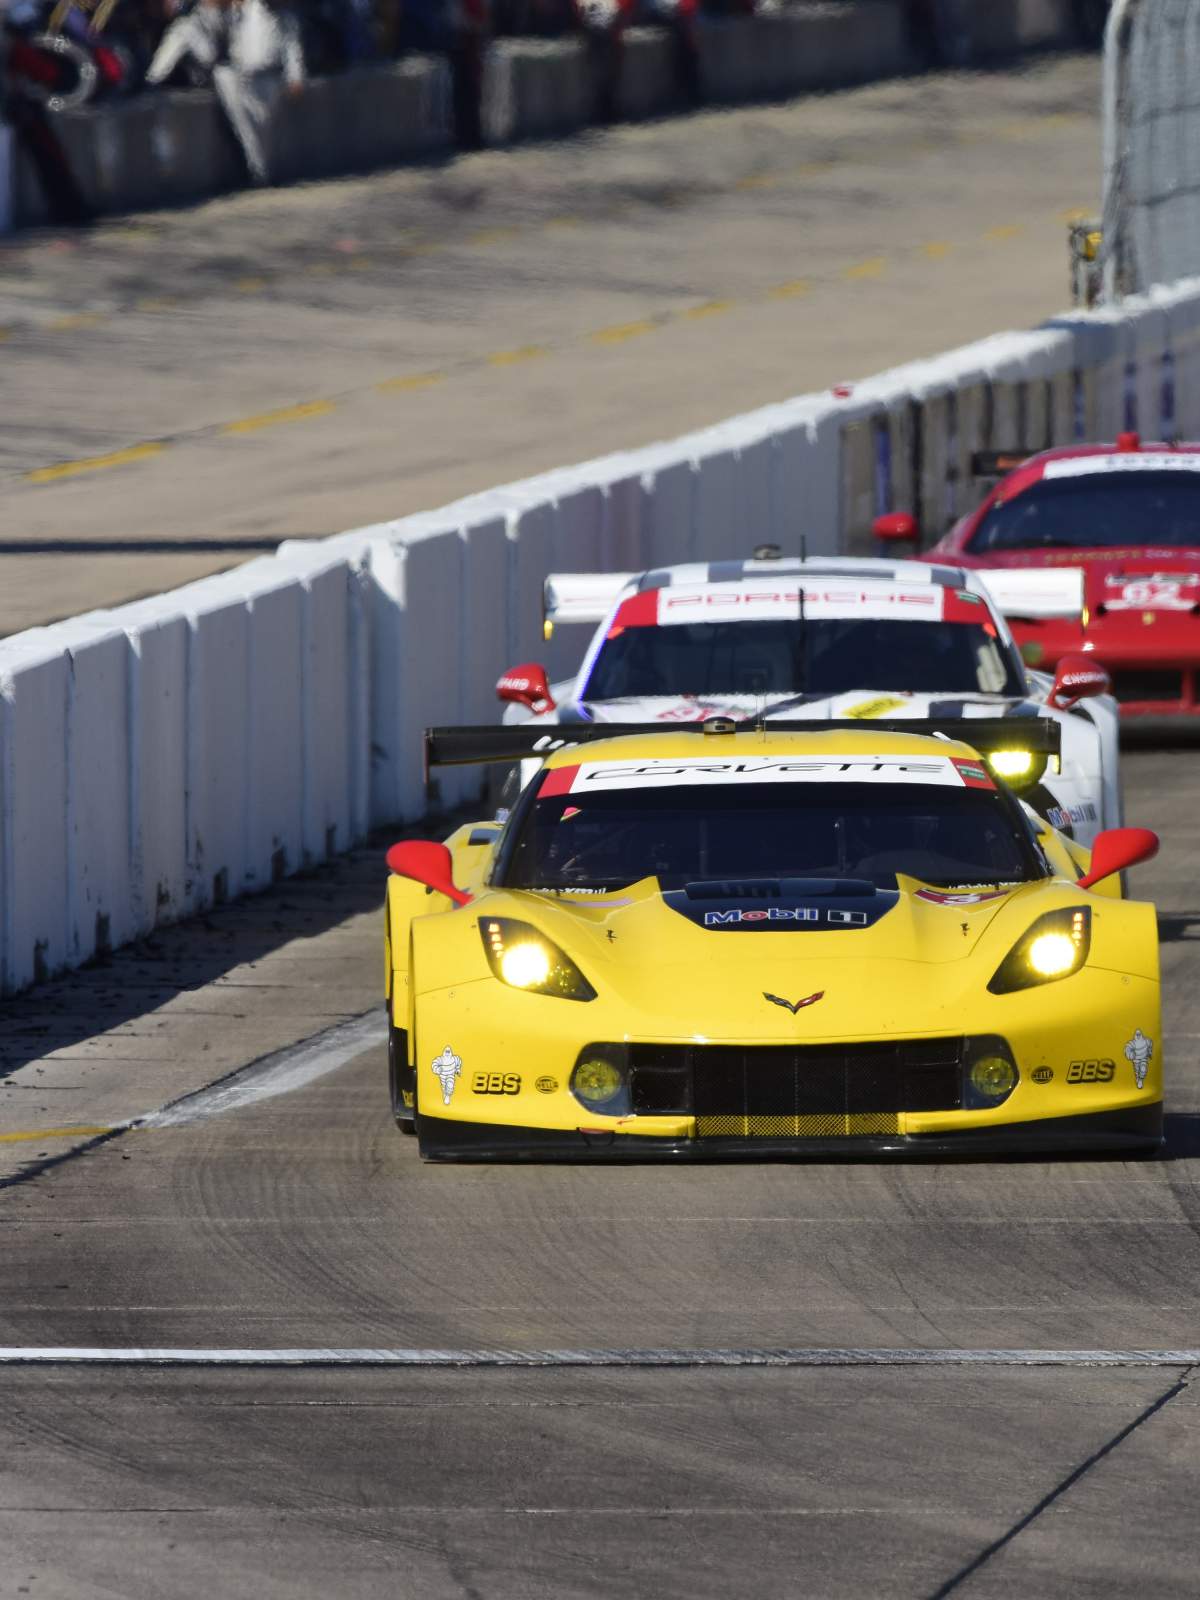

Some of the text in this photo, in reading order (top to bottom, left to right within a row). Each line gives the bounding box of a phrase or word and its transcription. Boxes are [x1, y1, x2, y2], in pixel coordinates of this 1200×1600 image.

[666, 593, 935, 607] PORSCHE
[585, 762, 945, 781] CORVETTE
[704, 908, 819, 925] Mobil
[1066, 1059, 1116, 1084] BBS
[472, 1071, 522, 1095] BBS
